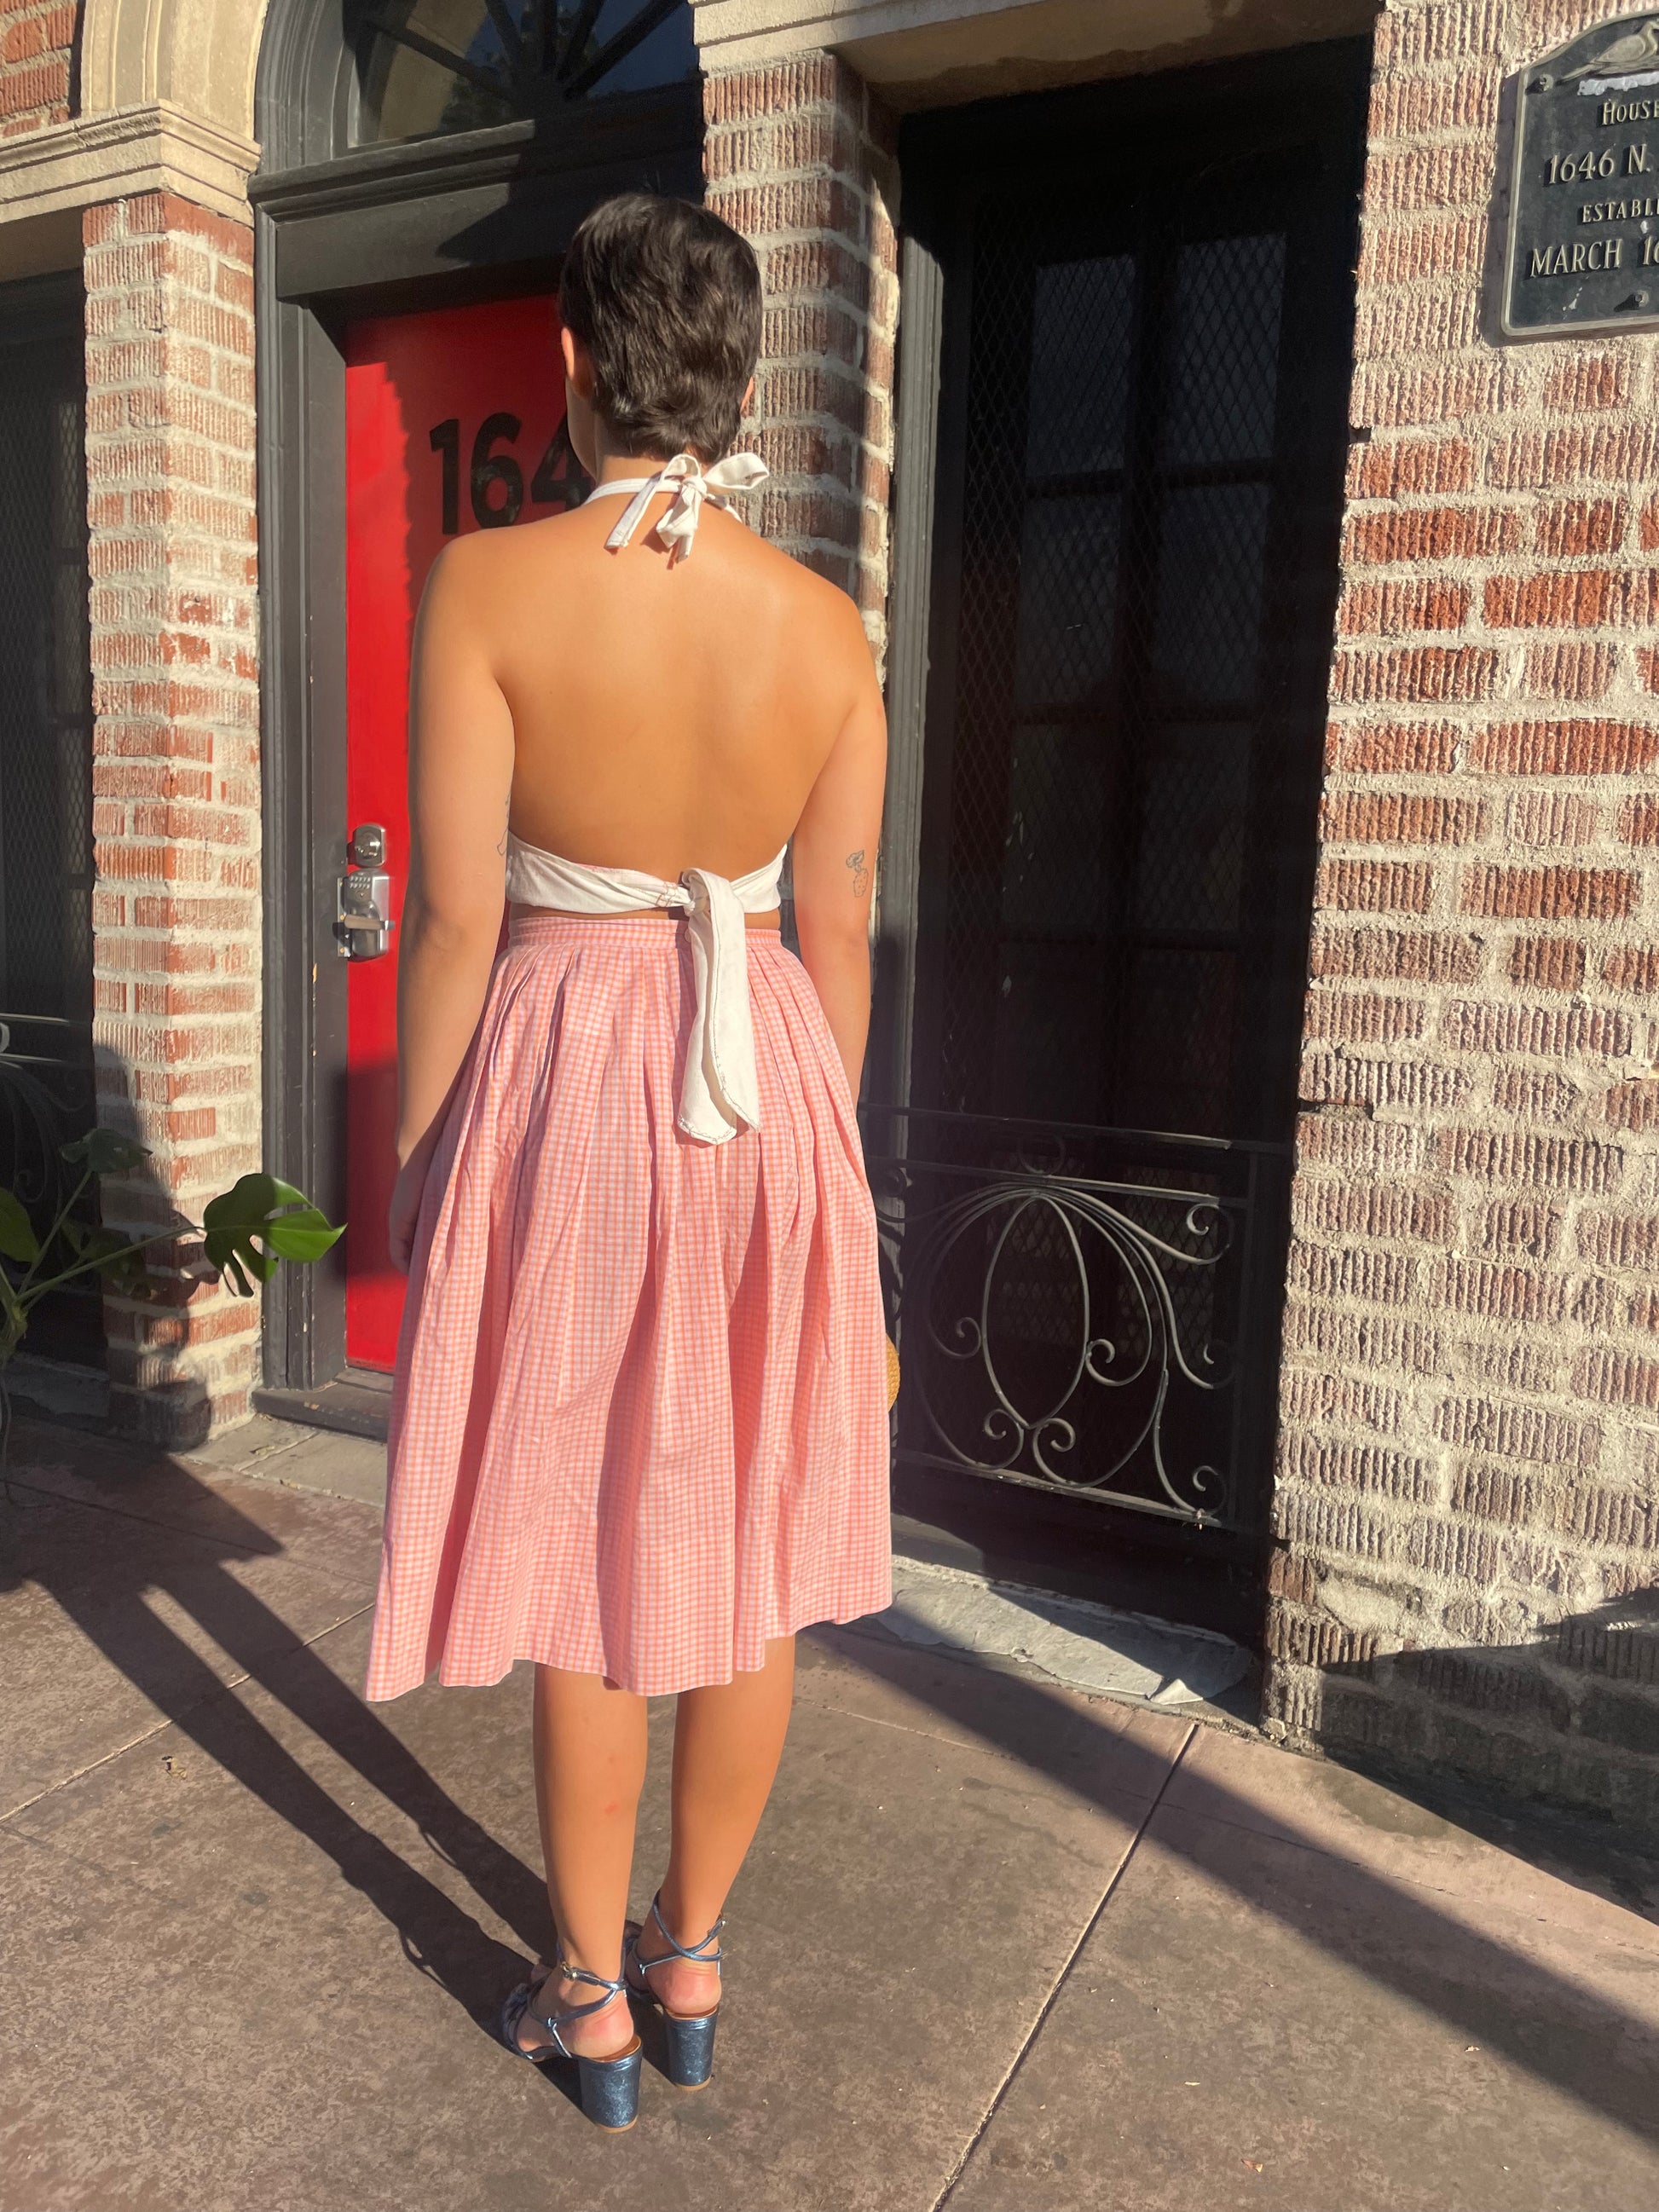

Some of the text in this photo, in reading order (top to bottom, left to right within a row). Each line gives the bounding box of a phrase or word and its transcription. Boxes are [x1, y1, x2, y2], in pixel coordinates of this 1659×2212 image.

[1602, 100, 1659, 125] HOUSE
[1549, 143, 1651, 184] 1646 N.
[1529, 238, 1623, 277] MARCH
[429, 412, 595, 535] 164
